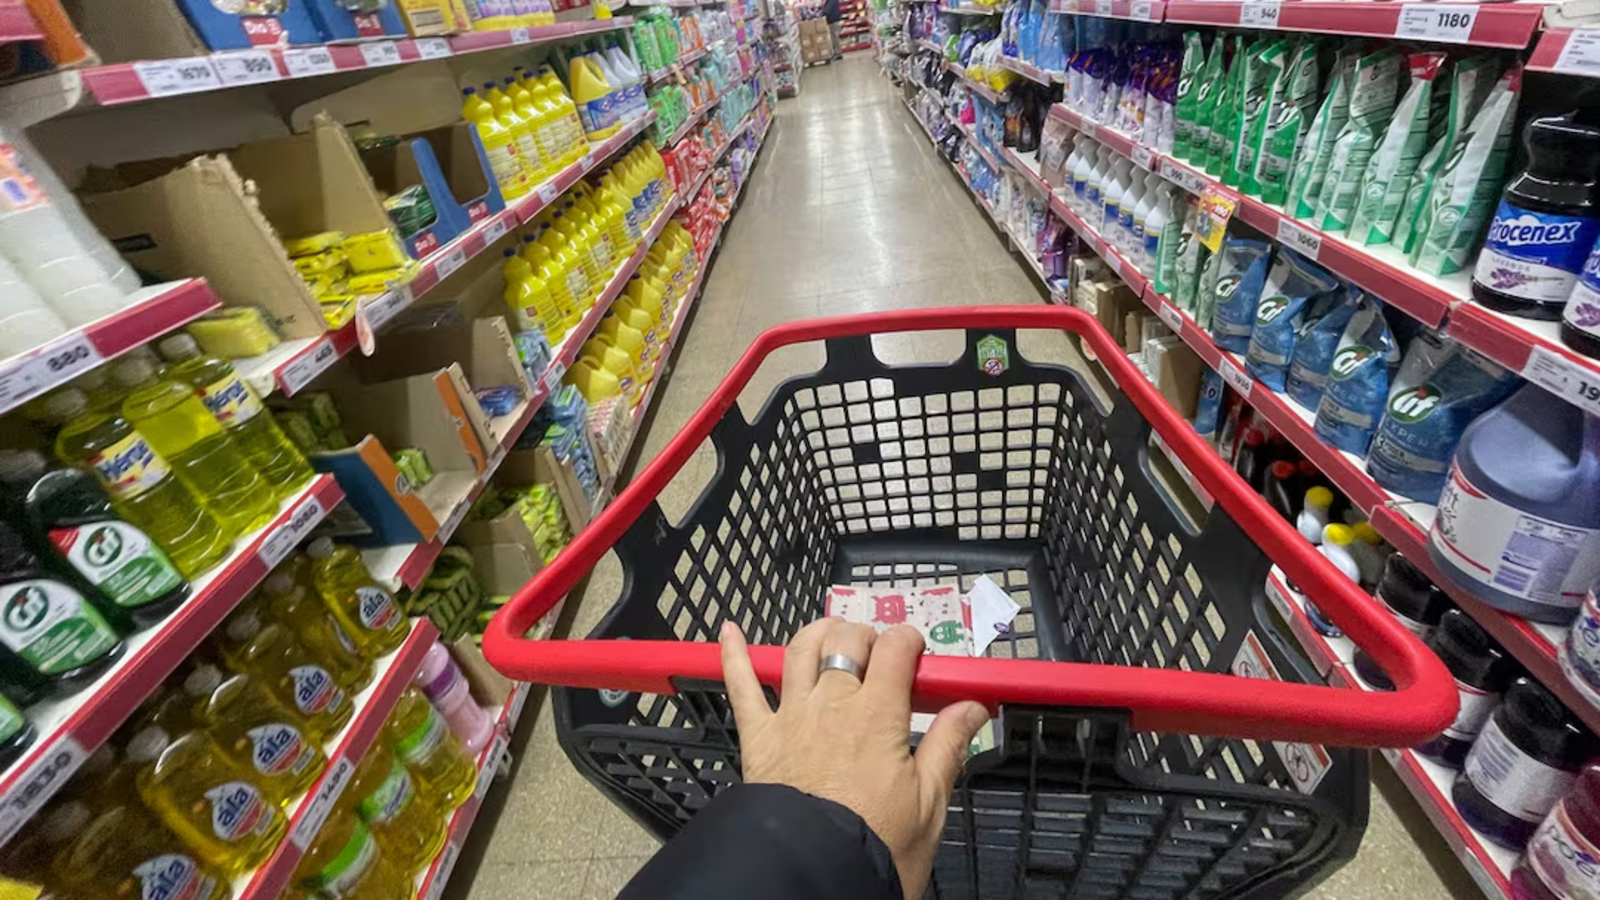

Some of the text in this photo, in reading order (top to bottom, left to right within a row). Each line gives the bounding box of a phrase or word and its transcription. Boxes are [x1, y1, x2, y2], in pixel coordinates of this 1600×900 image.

[1261, 8, 1277, 20] 940
[1438, 13, 1471, 28] 1180
[1296, 230, 1318, 250] 1060
[1488, 215, 1582, 245] Procenex
[46, 345, 90, 373] 880
[1392, 390, 1441, 417] Cif
[1578, 381, 1600, 401] 19
[290, 504, 318, 533] 1080
[88, 526, 121, 565] Cif
[9, 586, 47, 627] Cif
[11, 751, 72, 810] 1830
